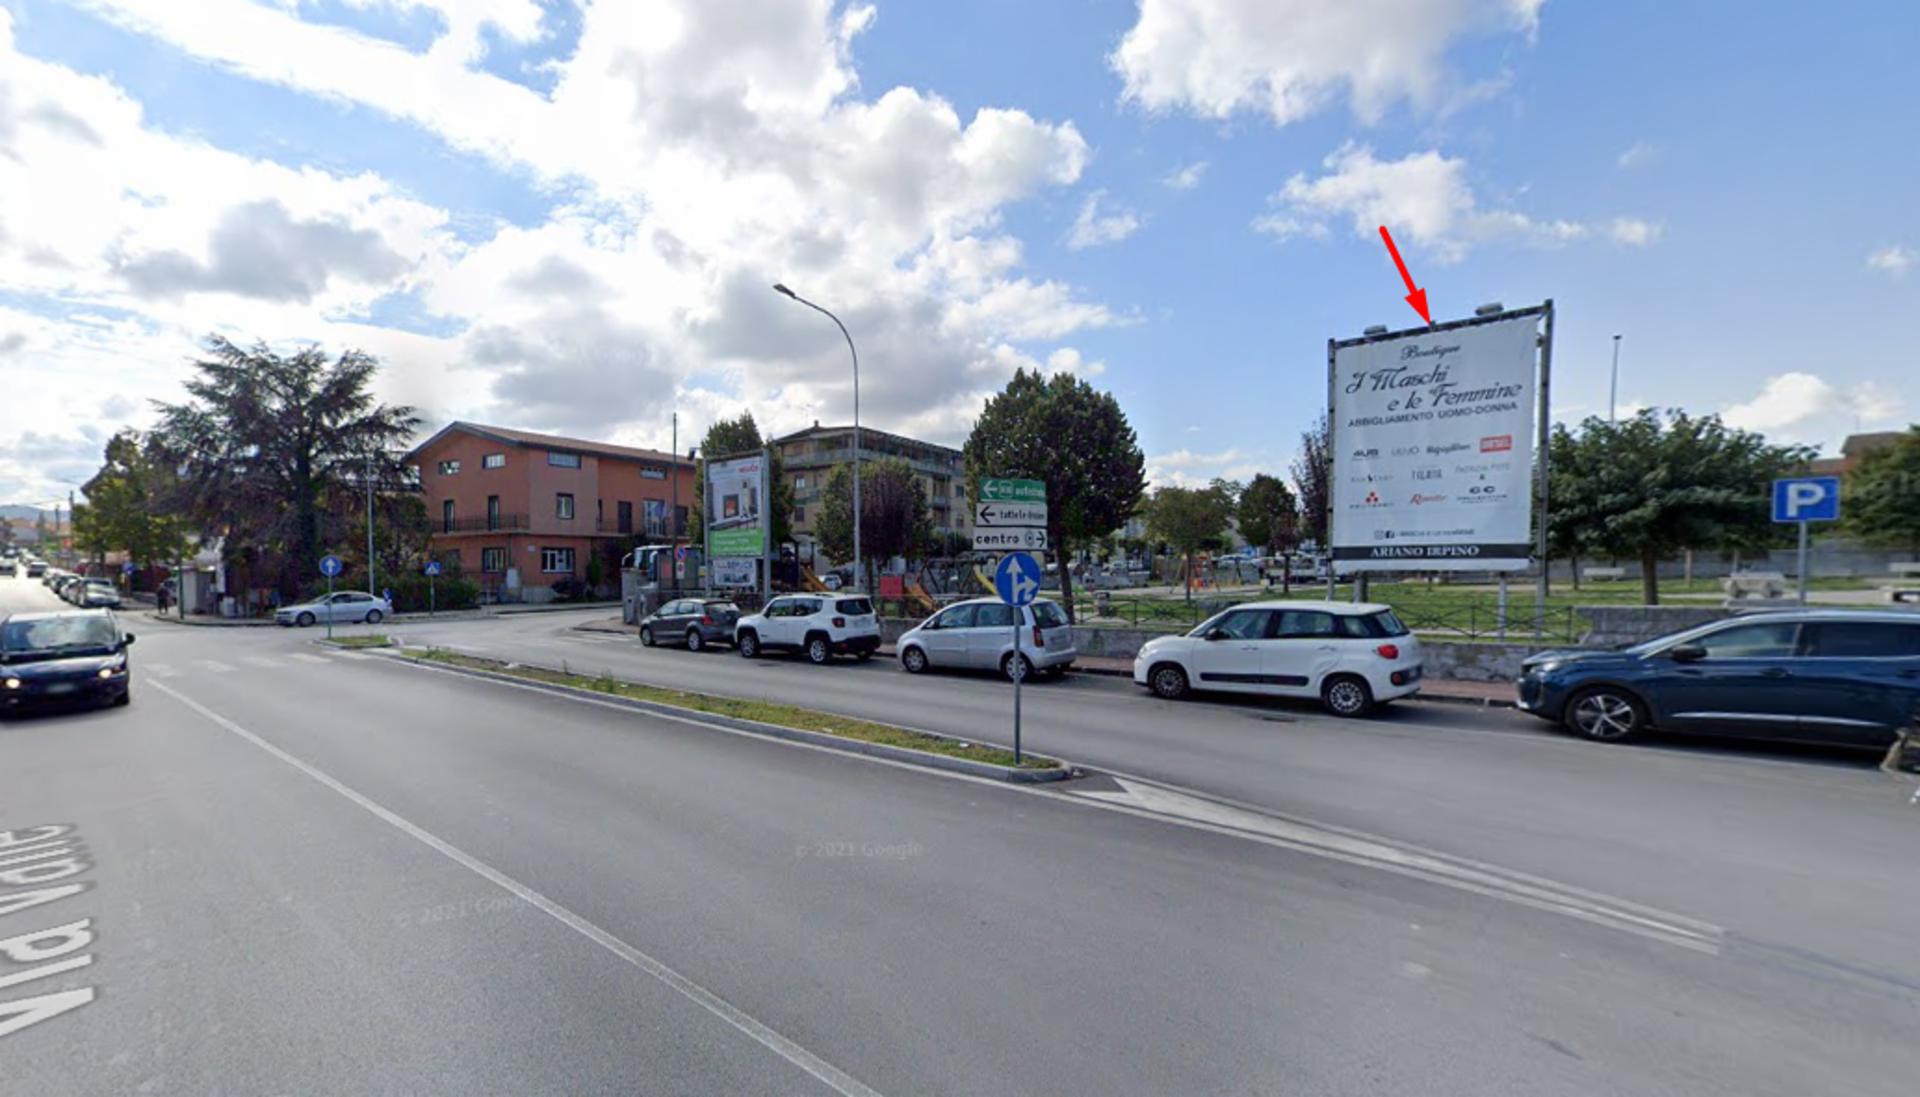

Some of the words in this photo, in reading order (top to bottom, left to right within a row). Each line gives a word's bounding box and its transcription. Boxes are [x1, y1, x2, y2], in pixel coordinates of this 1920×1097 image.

[1400, 343, 1461, 361] Boutique
[1369, 364, 1451, 391] Maschi
[1387, 399, 1400, 412] e
[1404, 390, 1423, 410] le
[1429, 382, 1523, 407] Femmine
[1347, 411, 1434, 428] ABBIGLIAMENTO
[1437, 401, 1518, 420] UOMO-DONNA
[1786, 483, 1825, 518] P
[976, 533, 1020, 544] centro
[1370, 546, 1424, 558] ARIANO
[1426, 545, 1480, 557] IRPINO
